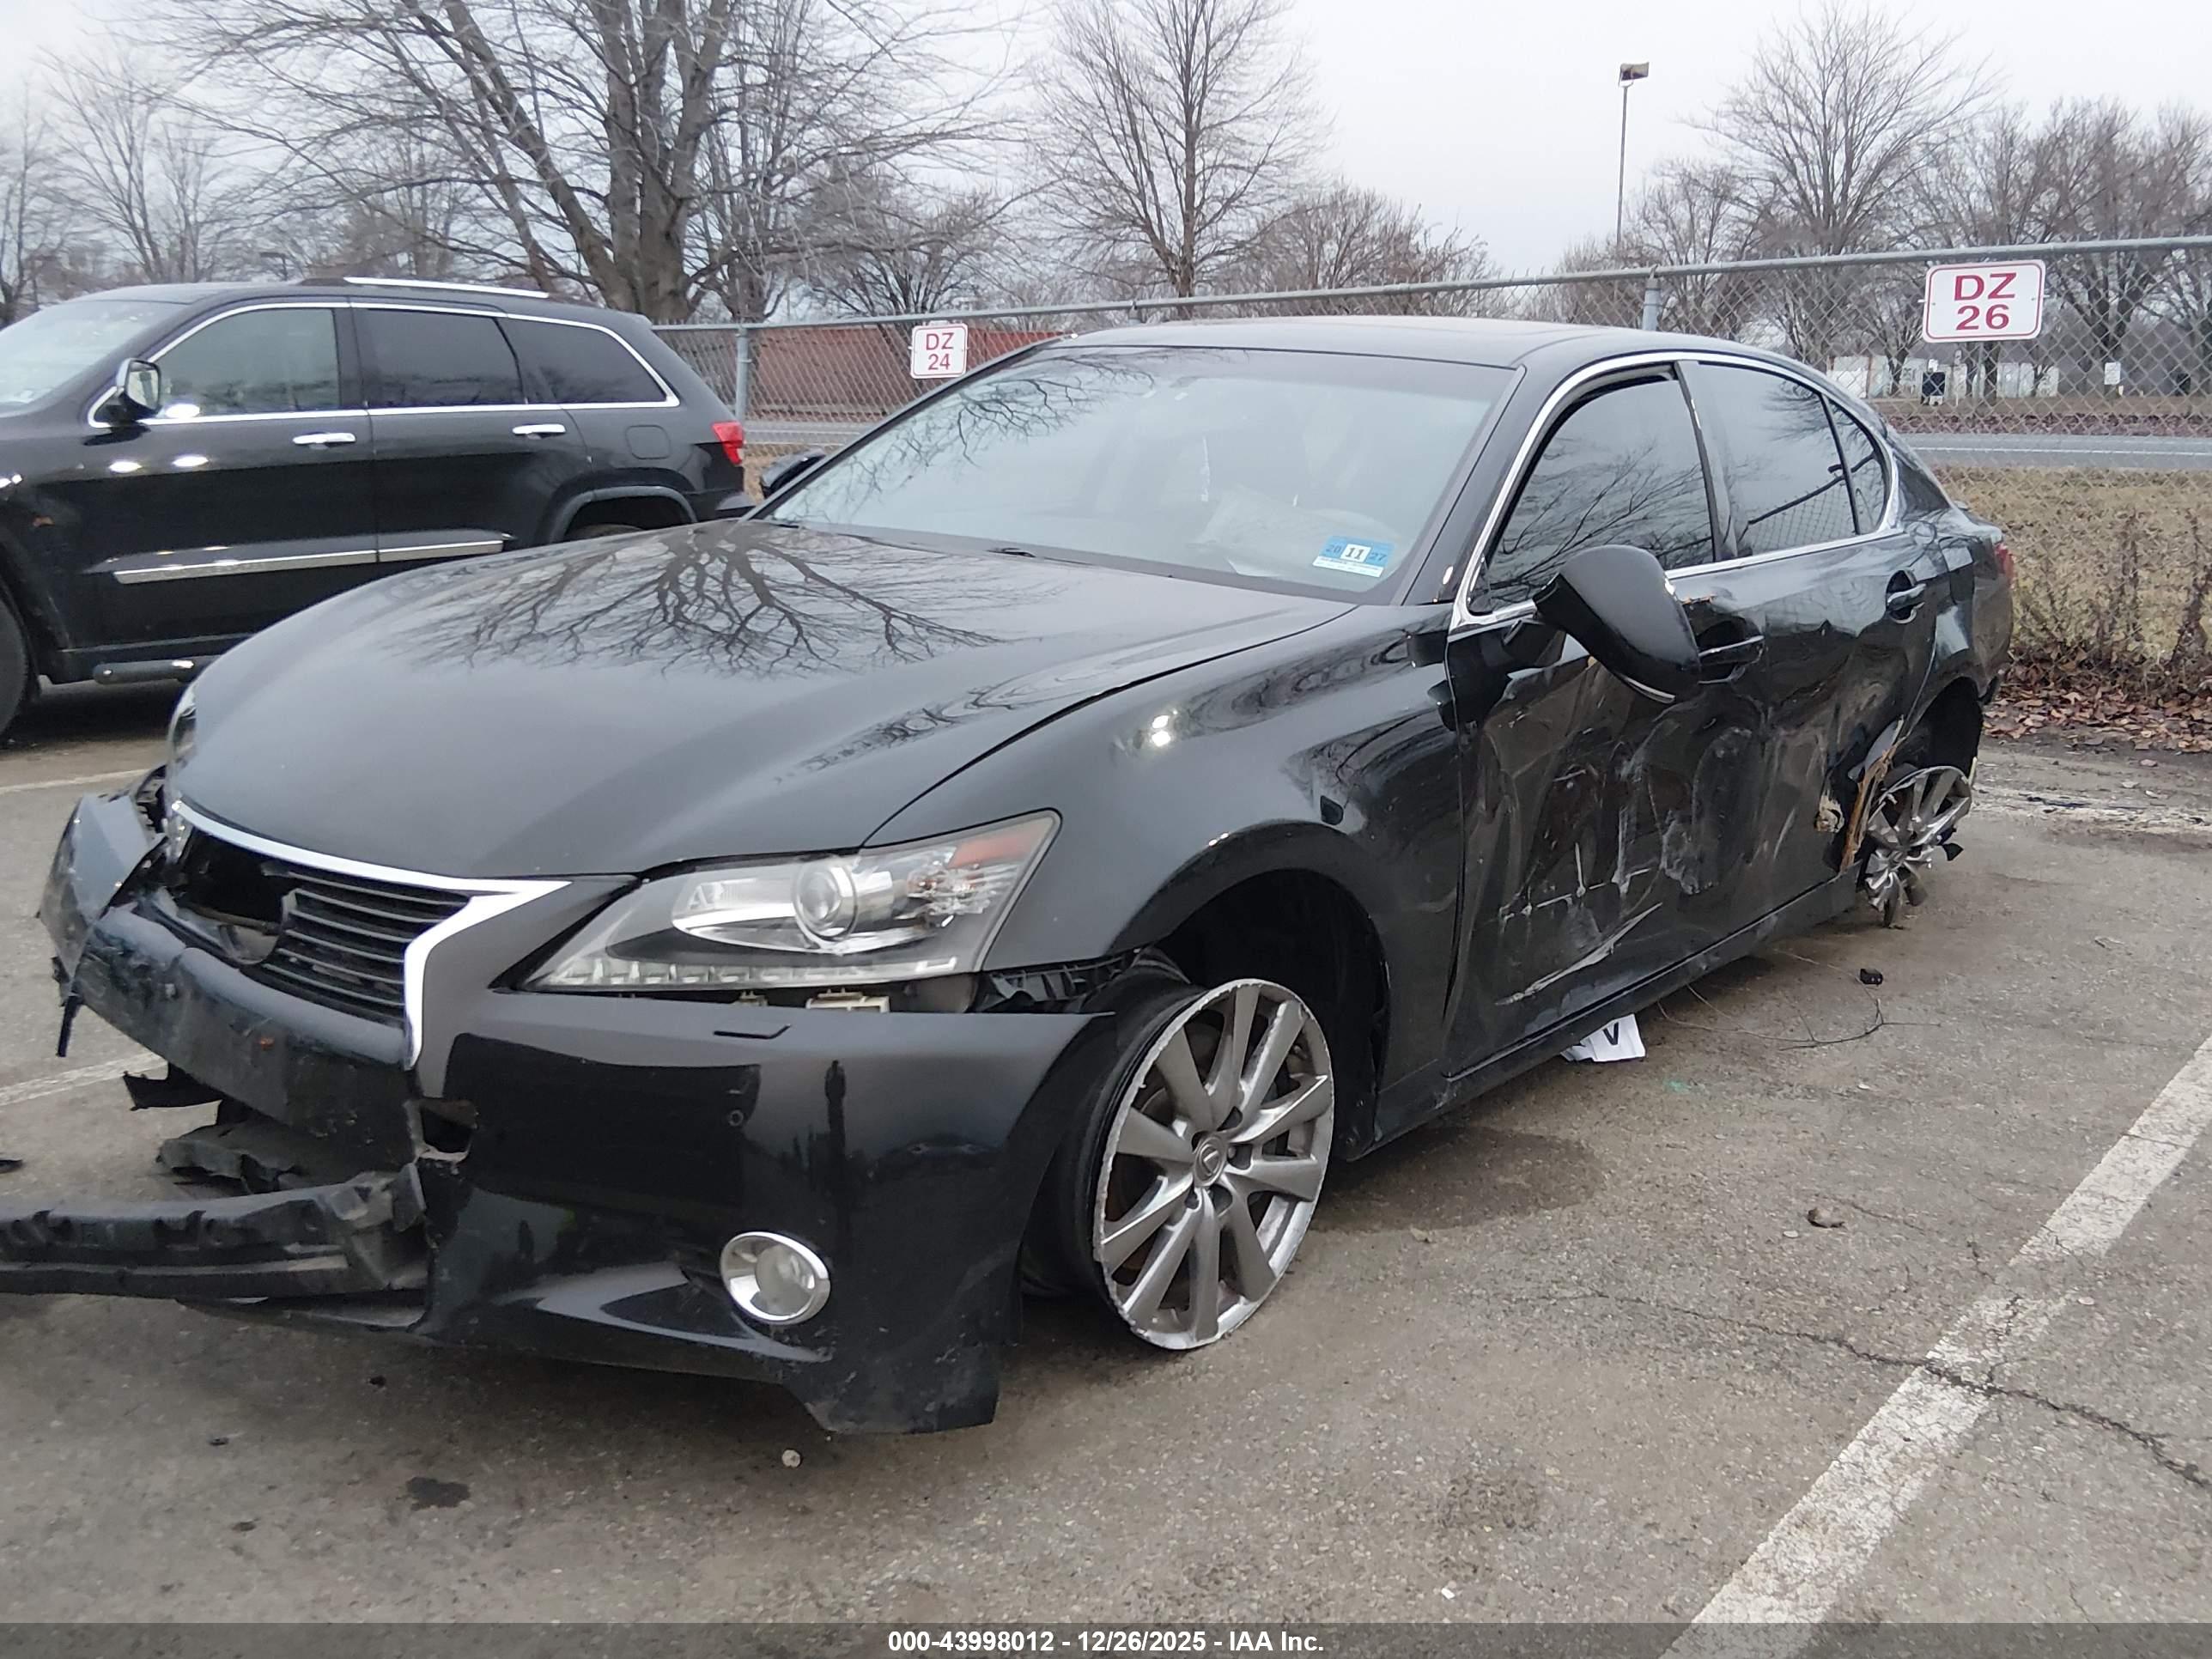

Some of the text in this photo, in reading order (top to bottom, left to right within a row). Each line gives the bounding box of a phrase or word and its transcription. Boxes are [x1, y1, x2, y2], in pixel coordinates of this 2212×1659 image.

[1954, 272, 2016, 301] DZ
[1956, 304, 2009, 331] 26
[926, 332, 954, 350] DZ
[927, 353, 951, 370] 24
[1345, 547, 1364, 560] 11
[1368, 552, 1388, 562] 27
